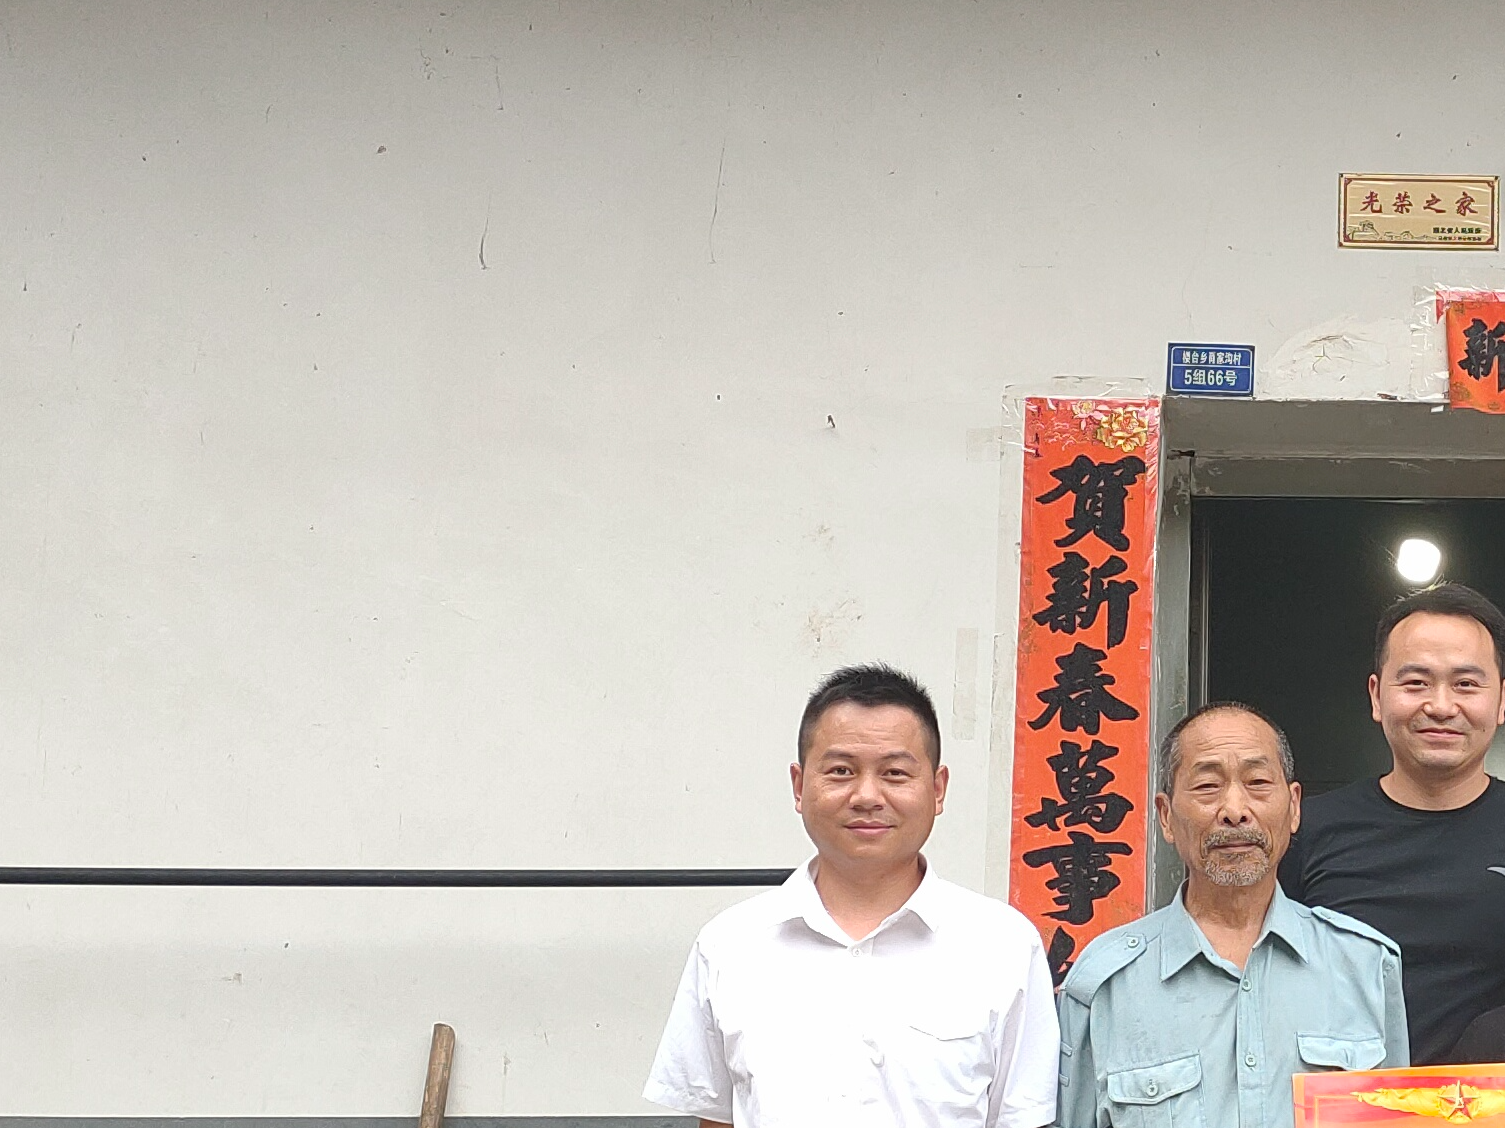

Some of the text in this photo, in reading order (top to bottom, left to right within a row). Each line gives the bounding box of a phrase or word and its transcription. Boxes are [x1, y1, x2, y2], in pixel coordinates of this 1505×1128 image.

[1360, 190, 1478, 216] 光荣之家
[1184, 368, 1237, 386] 5组66号
